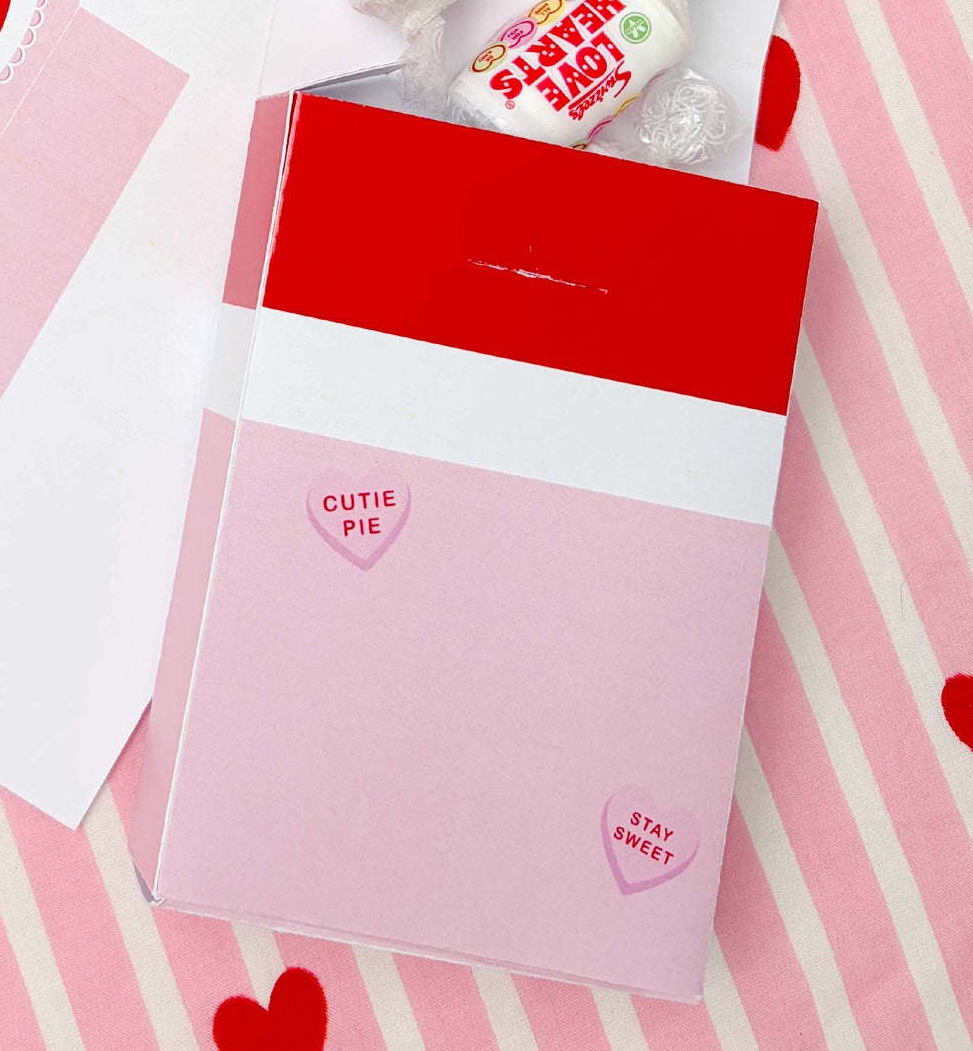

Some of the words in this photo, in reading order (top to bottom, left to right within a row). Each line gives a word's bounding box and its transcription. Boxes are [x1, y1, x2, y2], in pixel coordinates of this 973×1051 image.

[512, 30, 524, 40] FOR
[535, 31, 625, 111] LOVE
[323, 490, 396, 512] CUTIE
[343, 517, 381, 537] PIE
[630, 811, 674, 841] STAY
[613, 826, 674, 865] SWEET
